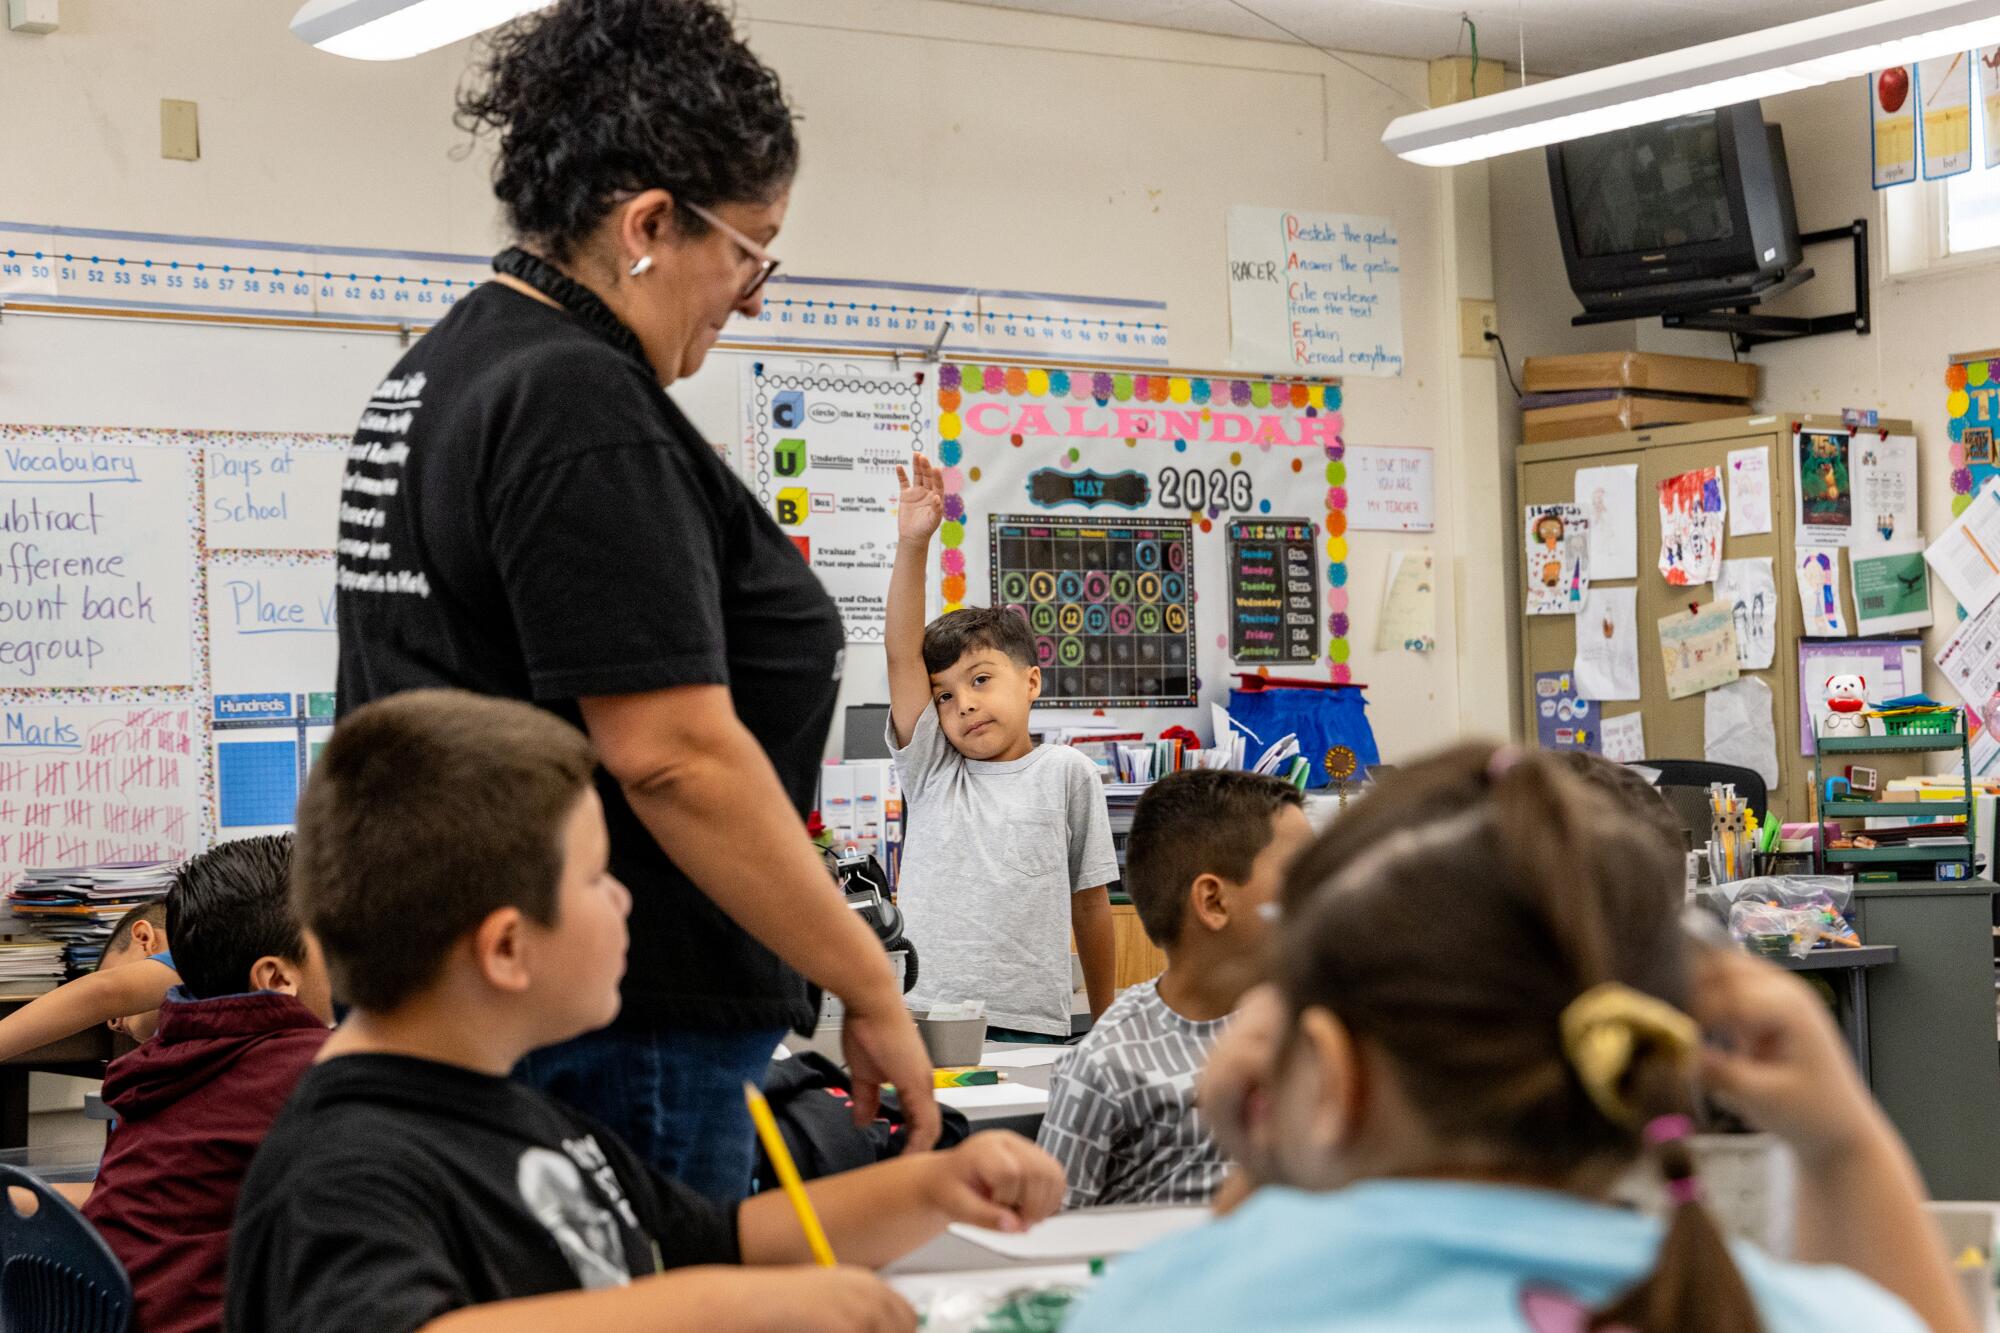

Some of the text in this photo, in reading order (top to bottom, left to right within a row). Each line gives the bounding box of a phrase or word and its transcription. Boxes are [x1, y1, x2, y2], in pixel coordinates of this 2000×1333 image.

[1342, 223, 1361, 242] the
[1231, 260, 1279, 284] RACER
[1340, 253, 1357, 272] the
[3, 264, 21, 276] 49
[32, 264, 49, 278] 50
[61, 267, 76, 280] 51
[88, 269, 104, 283] 52
[114, 271, 131, 285] 53
[140, 273, 157, 286] 54
[167, 274, 183, 288] 55
[193, 276, 209, 290] 56
[219, 278, 235, 290] 57
[244, 280, 260, 293] 58
[269, 282, 285, 294] 59
[294, 283, 309, 296] 60
[321, 285, 334, 297] 61
[345, 287, 361, 299] 62
[370, 288, 385, 300] 63
[395, 290, 410, 301] 64
[418, 291, 432, 303] 65
[1291, 303, 1372, 317] from the text
[758, 311, 771, 322] 80
[780, 312, 792, 323] 81
[803, 313, 816, 324] 82
[824, 314, 837, 325] 83
[846, 315, 859, 326] 84
[867, 317, 880, 328] 85
[888, 318, 900, 329] 86
[905, 319, 917, 329] 87
[924, 320, 936, 331] 88
[962, 323, 974, 333] 90
[984, 324, 996, 335] 91
[1004, 326, 1016, 337] 92
[1024, 327, 1036, 337] 93
[1042, 328, 1054, 339] 94
[1060, 329, 1072, 340] 95
[1079, 330, 1091, 341] 96
[1098, 332, 1109, 342] 97
[1116, 333, 1127, 344] 98
[1134, 334, 1146, 344] 99
[1151, 335, 1166, 346] 100
[1292, 321, 1340, 345] Explain
[1295, 340, 1344, 365] Reread
[773, 403, 793, 428] C
[840, 408, 853, 417] the
[874, 411, 910, 420] Numbers
[965, 402, 1344, 446] CALENDAR
[6, 448, 138, 480] Vocabulary
[210, 450, 296, 487] Days at
[774, 452, 796, 476] U
[811, 454, 853, 463] Underline
[857, 454, 870, 463] the
[1073, 480, 1105, 497] MAY
[1158, 466, 1253, 512] 2026
[1377, 477, 1394, 490] YOU
[0, 491, 103, 534] ubtract
[212, 491, 287, 523] School
[777, 499, 799, 525] B
[814, 498, 830, 507] Box
[1232, 526, 1264, 539] DAYS
[1275, 526, 1310, 539] WEEK
[0, 542, 125, 585] fference
[818, 547, 856, 555] Evaluate
[0, 581, 156, 623] ount back
[224, 580, 304, 626] Place
[838, 595, 883, 603] and Check
[0, 637, 104, 676] egroup
[220, 699, 286, 713] Hundreds
[6, 712, 80, 744] Marks
